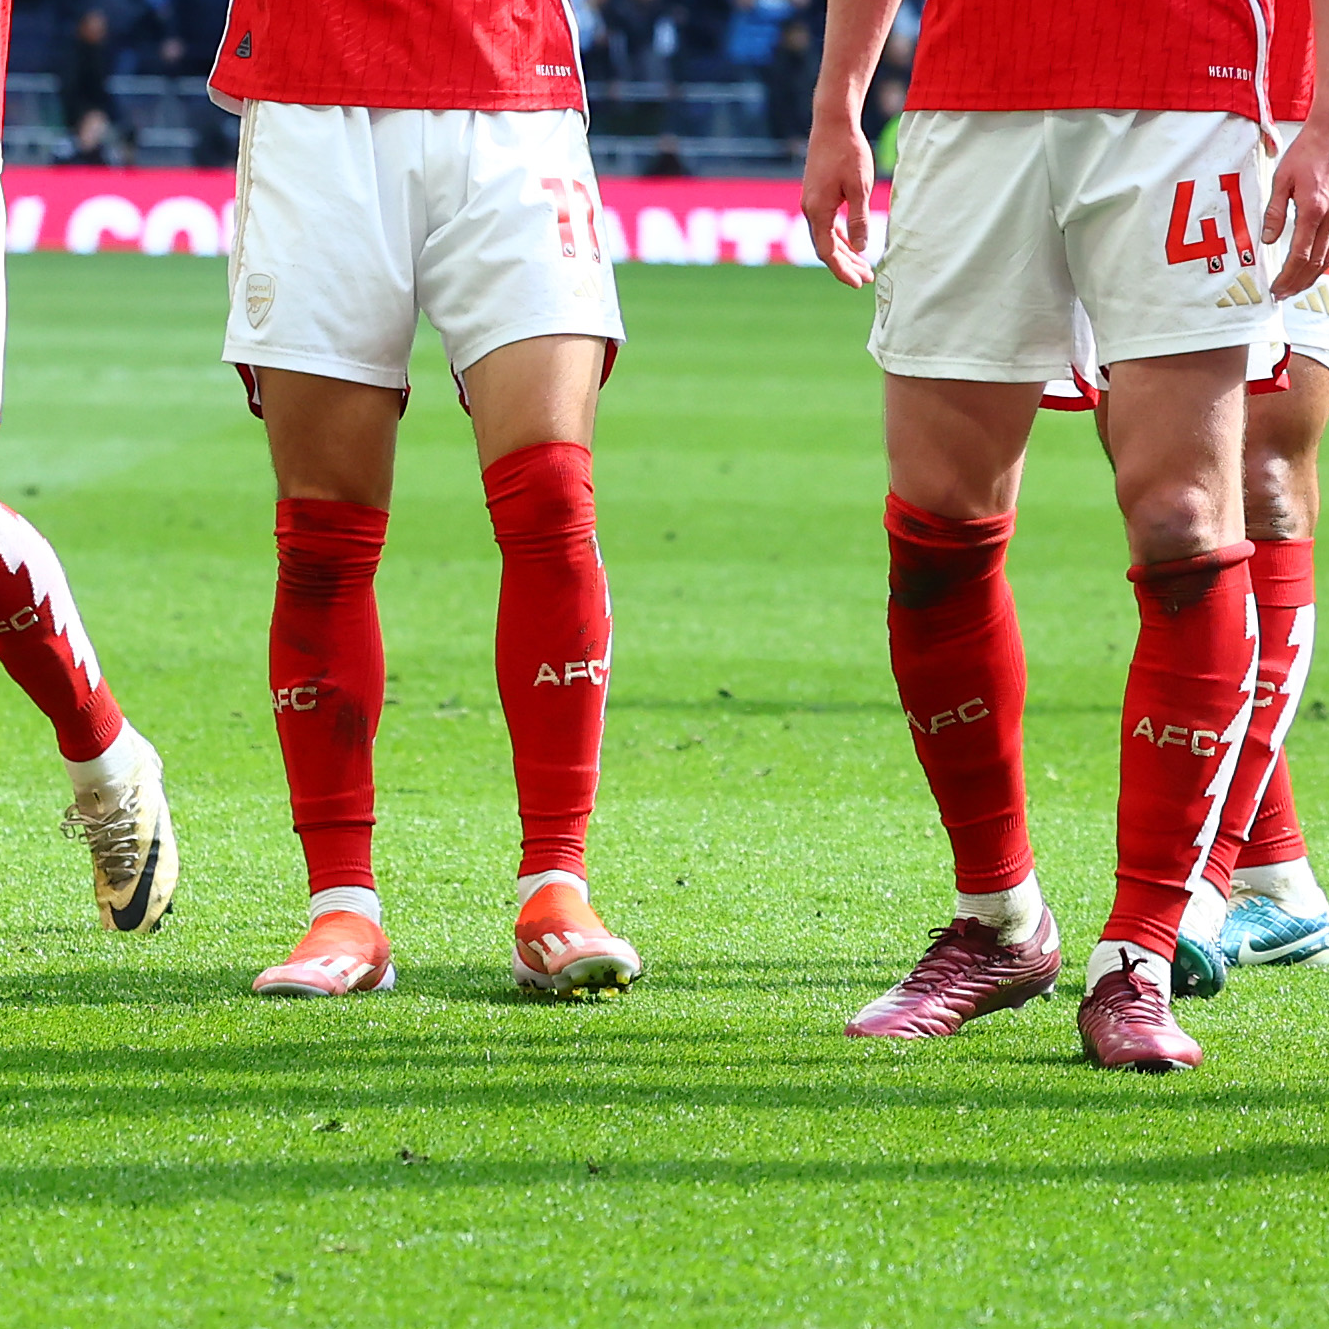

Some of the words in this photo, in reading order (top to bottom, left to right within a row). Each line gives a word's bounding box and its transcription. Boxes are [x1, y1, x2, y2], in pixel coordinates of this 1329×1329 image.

[540, 176, 601, 264] 11
[1164, 172, 1256, 274] 41
[533, 659, 603, 687] AFC
[1132, 716, 1219, 757] AFC
